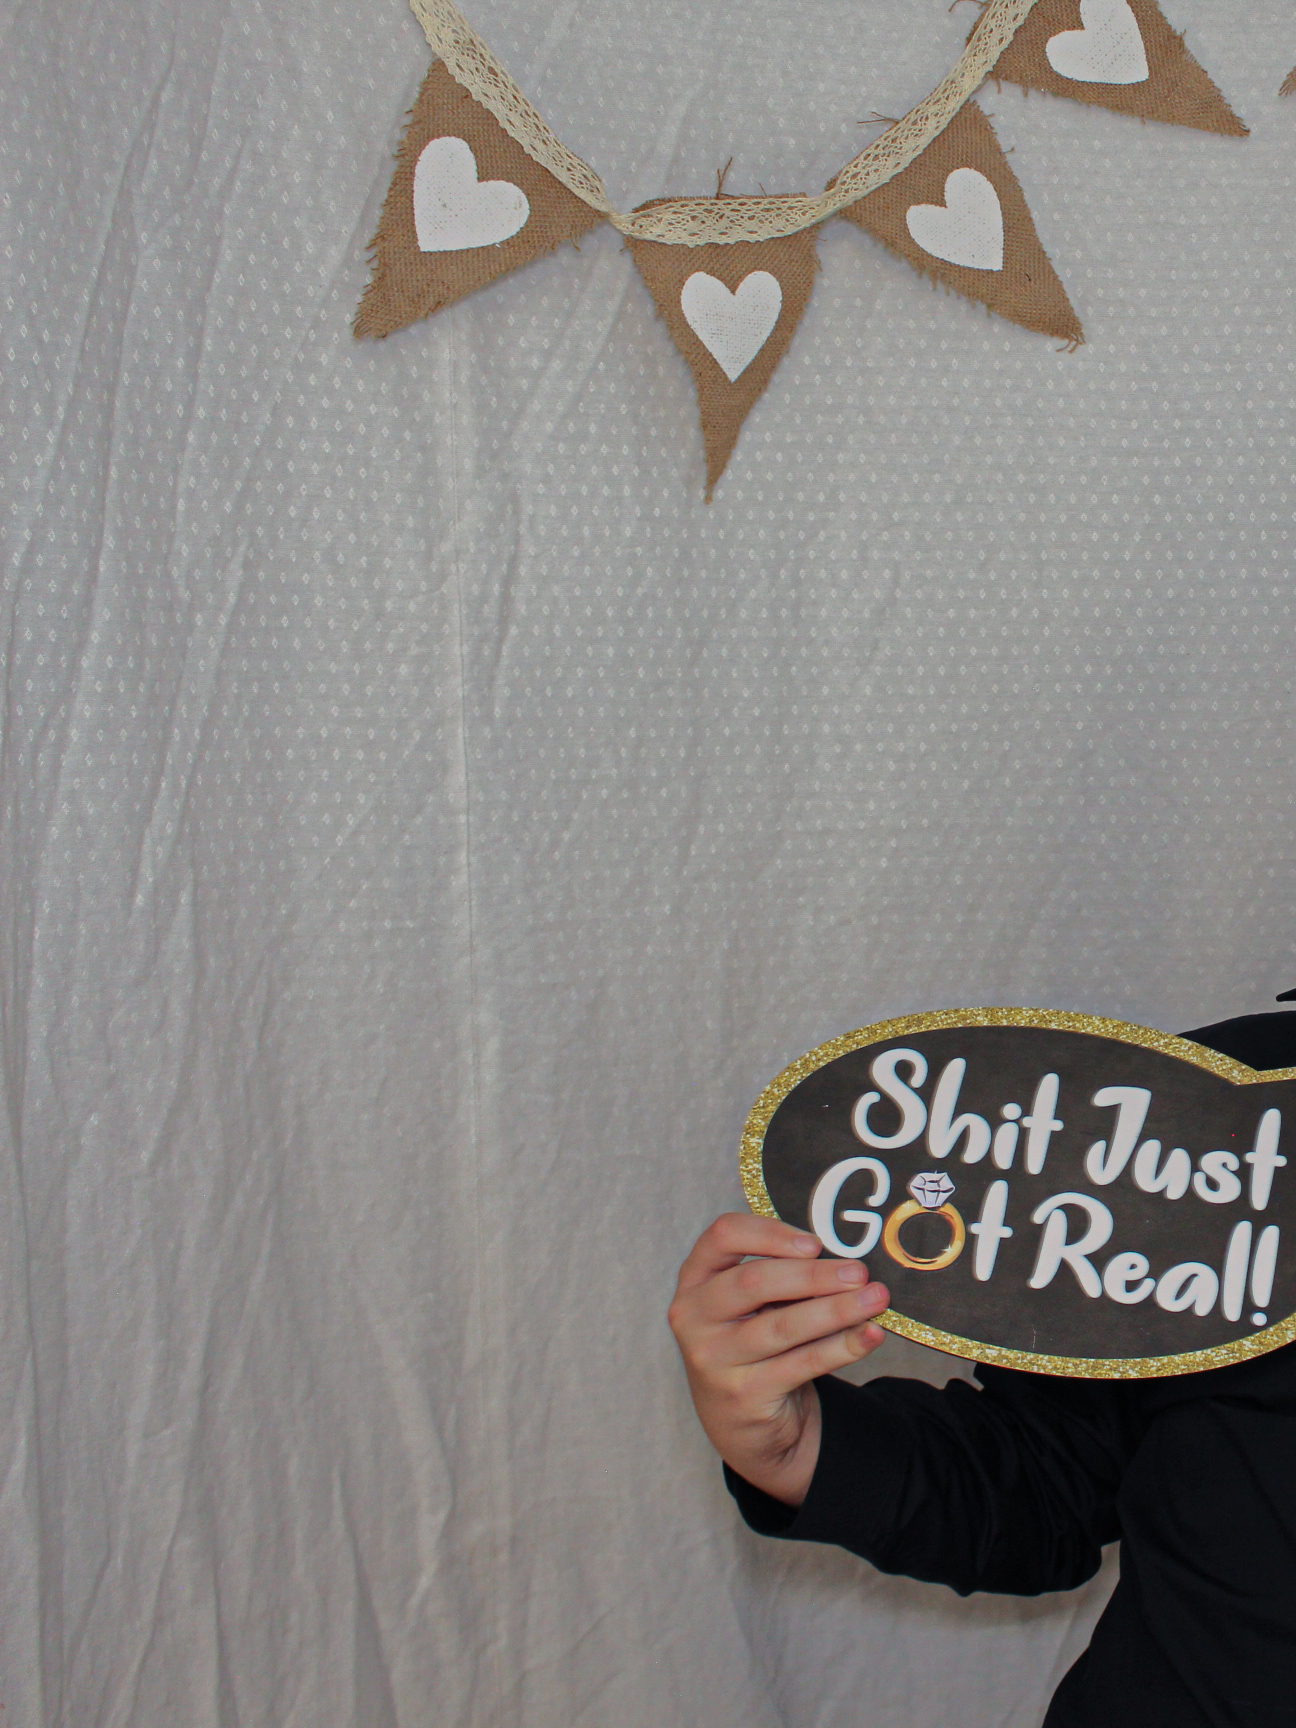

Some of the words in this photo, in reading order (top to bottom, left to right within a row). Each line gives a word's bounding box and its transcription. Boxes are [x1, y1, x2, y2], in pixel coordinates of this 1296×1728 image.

[852, 1047, 1065, 1176] Shit
[1084, 1085, 1289, 1211] Just
[809, 1156, 1014, 1283] Got
[1027, 1191, 1281, 1328] Real!
